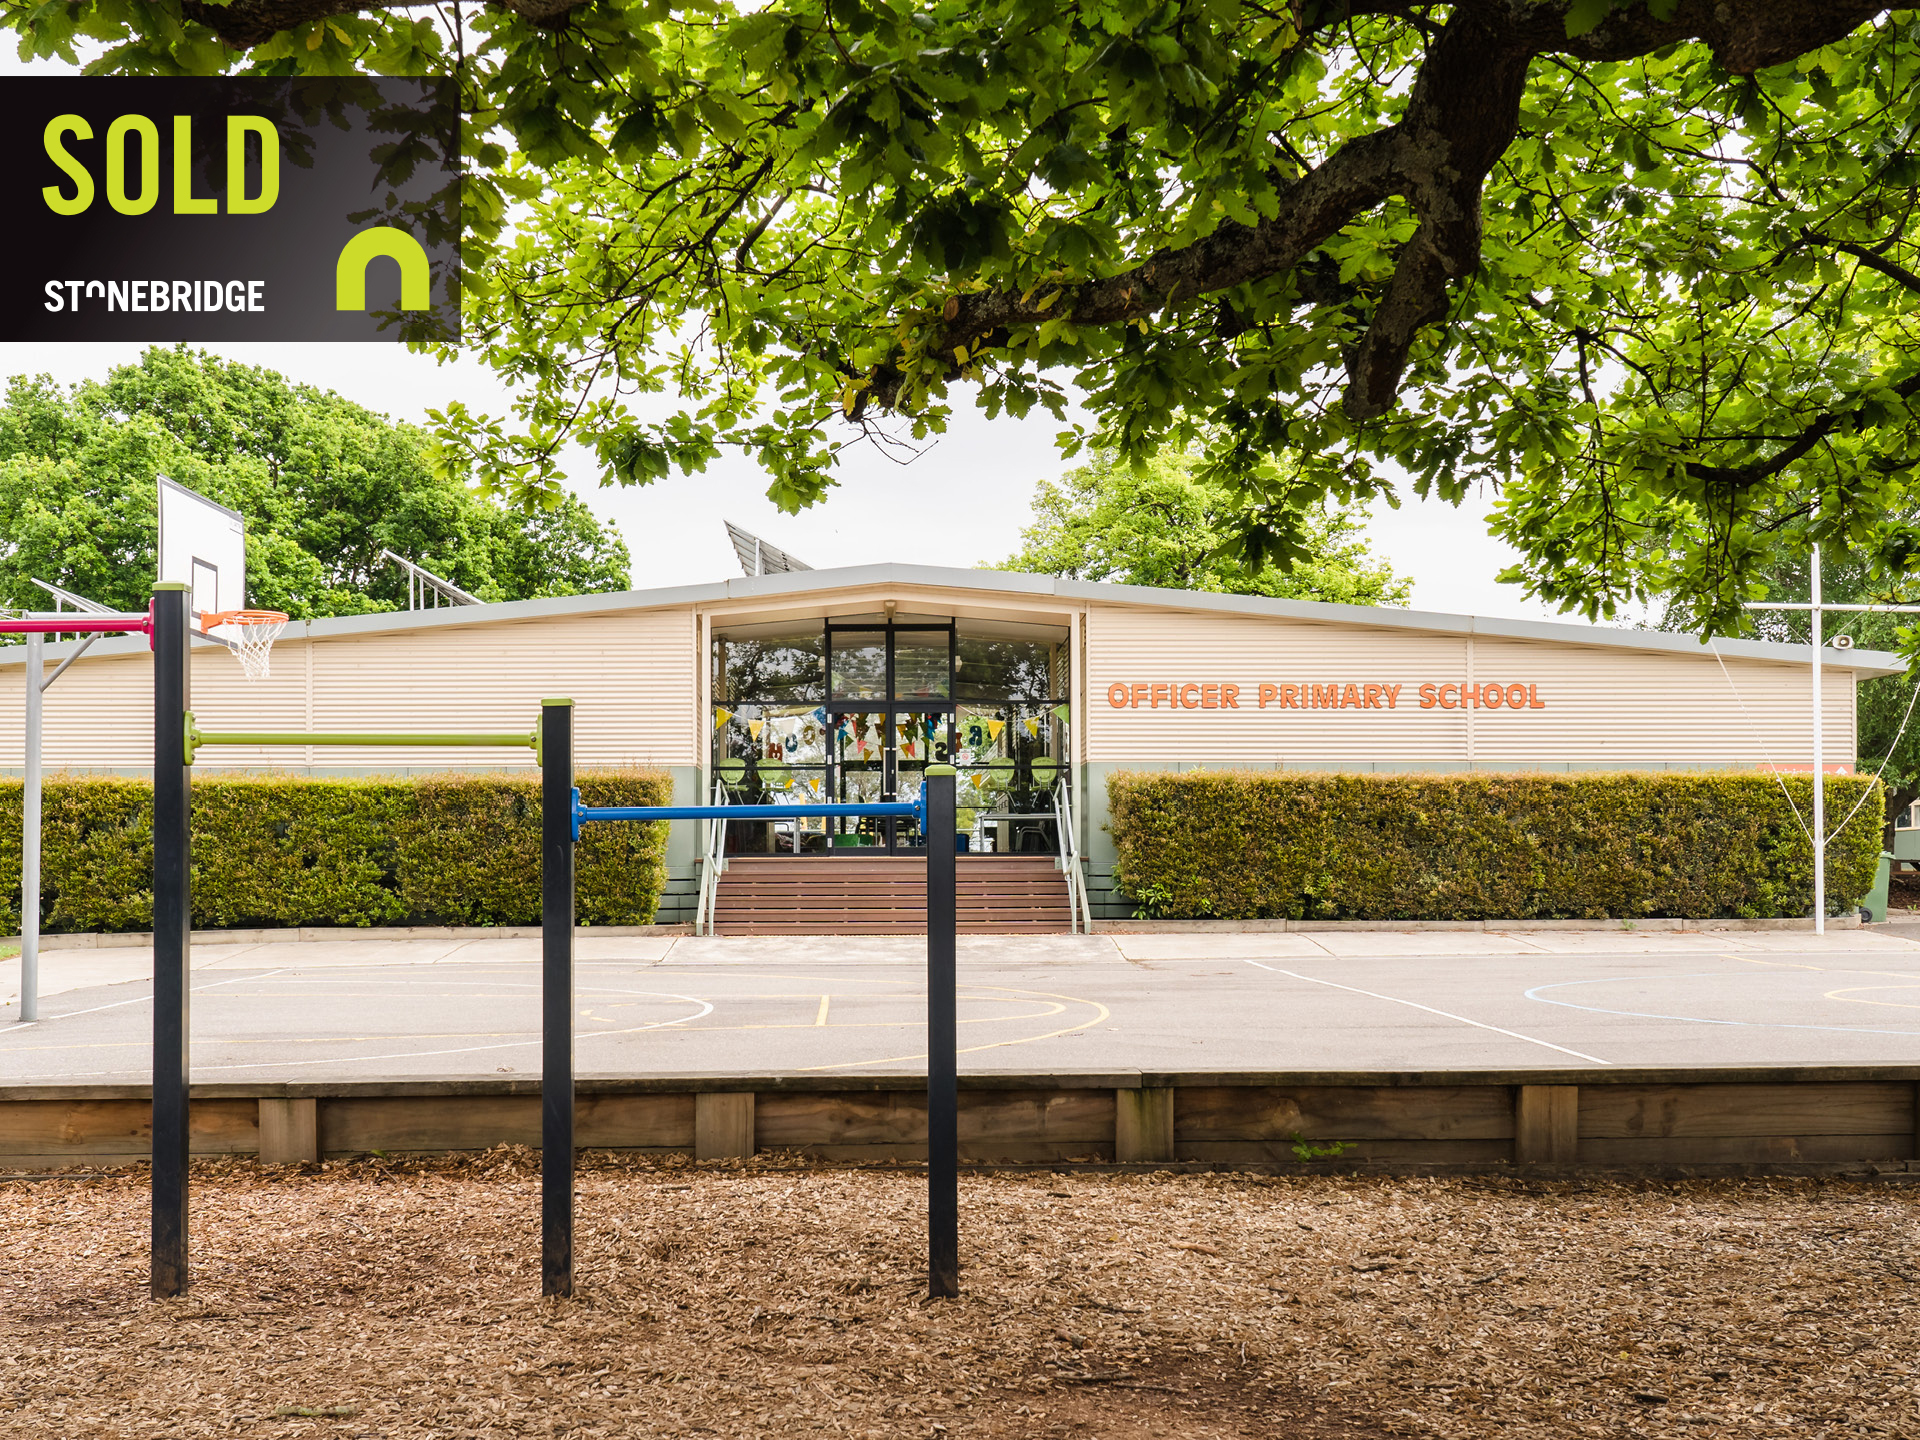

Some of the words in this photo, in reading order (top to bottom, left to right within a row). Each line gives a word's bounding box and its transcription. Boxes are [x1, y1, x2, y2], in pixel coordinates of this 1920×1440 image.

[1107, 682, 1240, 709] OFFICER
[1258, 683, 1402, 709] PRIMARY
[1419, 683, 1546, 709] SCHOOL
